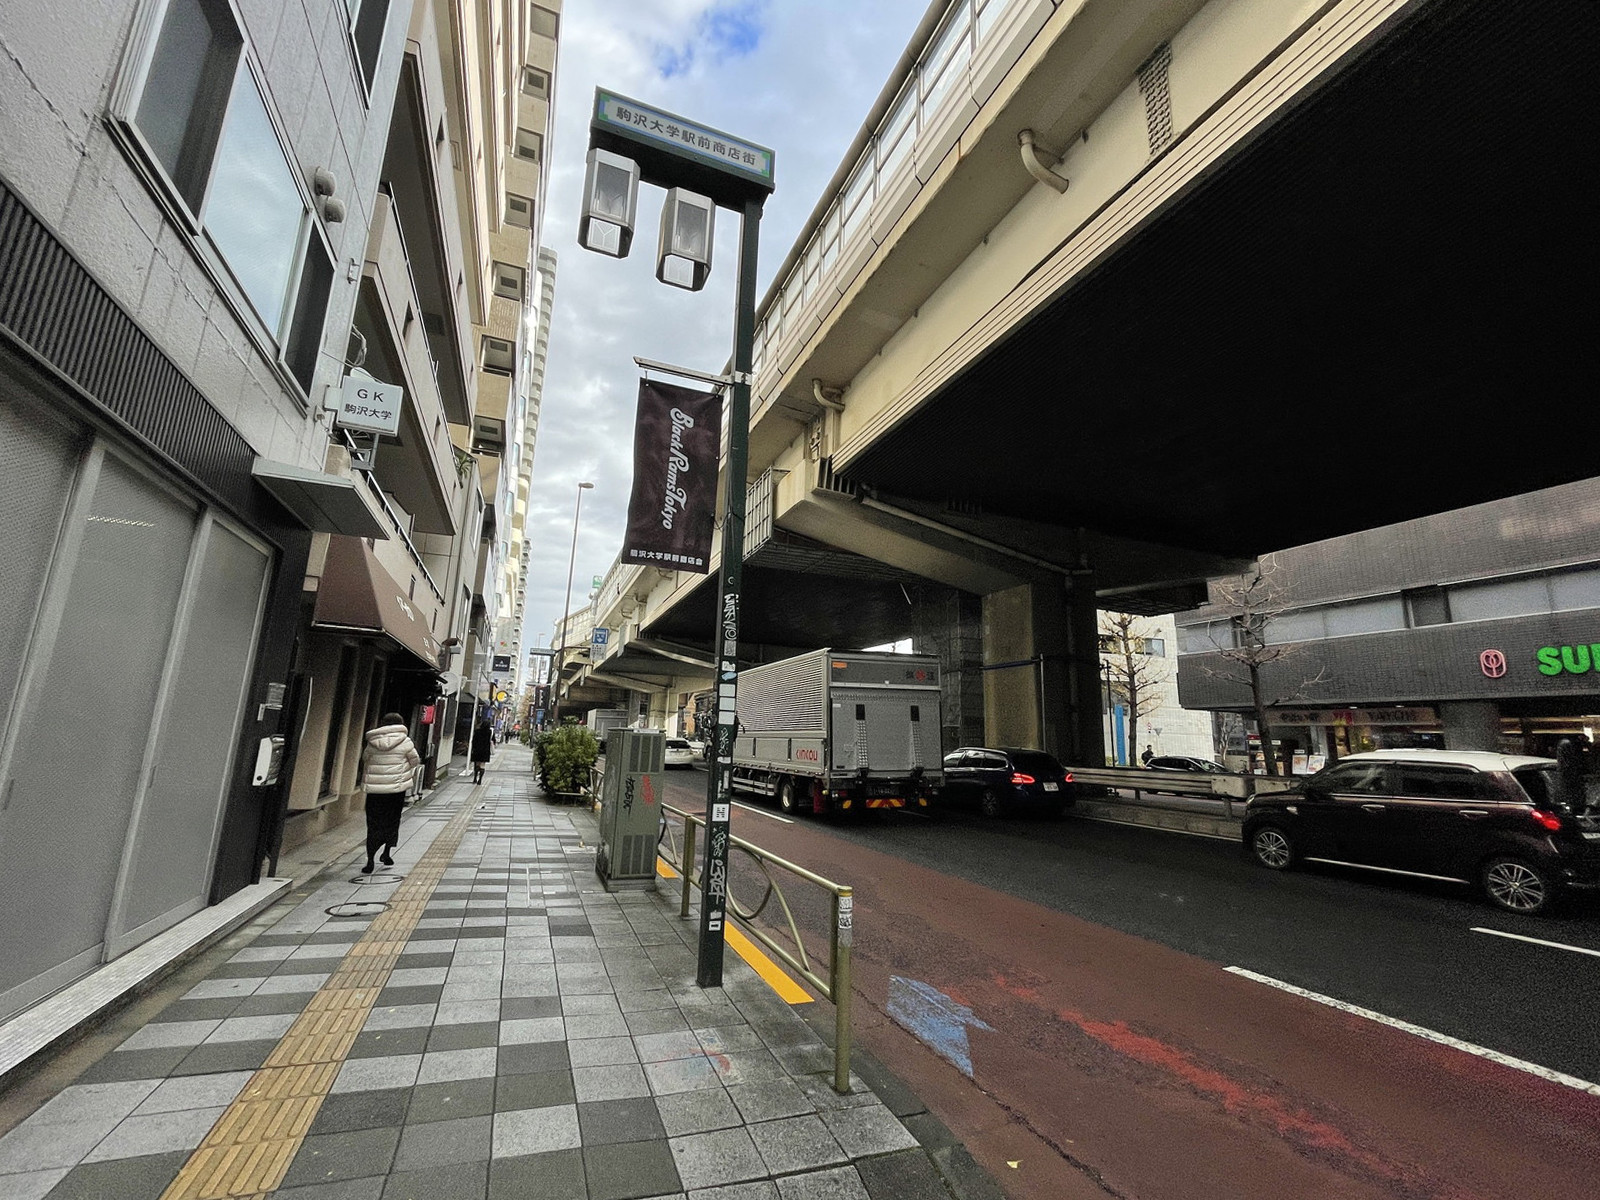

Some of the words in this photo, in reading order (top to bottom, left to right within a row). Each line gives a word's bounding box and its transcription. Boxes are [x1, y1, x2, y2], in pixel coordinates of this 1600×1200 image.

[616, 106, 756, 165] 駒沢大学駅前商店街
[344, 403, 392, 420] 駒沢大学
